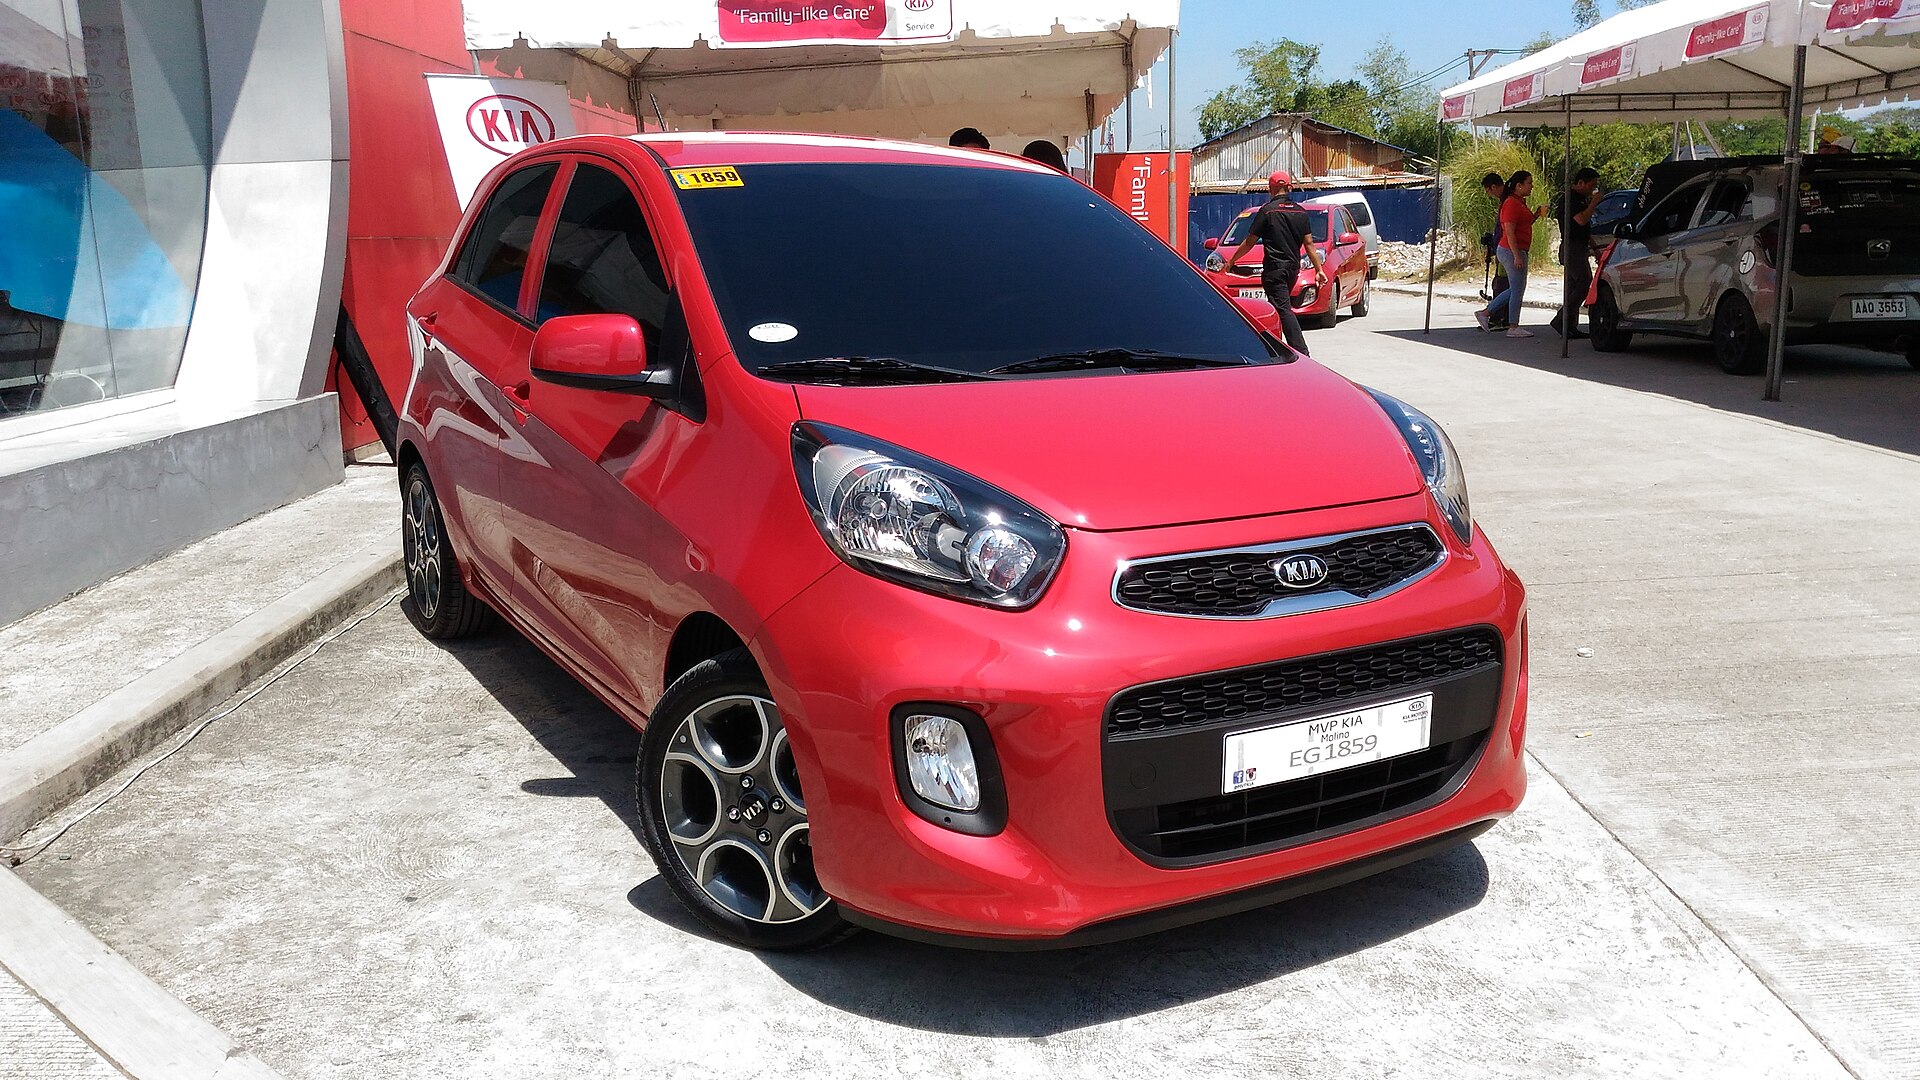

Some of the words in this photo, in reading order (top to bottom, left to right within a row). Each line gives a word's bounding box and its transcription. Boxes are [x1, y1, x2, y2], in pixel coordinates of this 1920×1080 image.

[909, 0, 929, 8] KIA
[733, 7, 829, 25] “Family-like
[833, 5, 875, 20] Care”
[906, 22, 935, 31] Service
[479, 109, 544, 143] KIA
[690, 171, 739, 184] 1859
[1284, 560, 1323, 582] KIA
[1308, 720, 1338, 737] MVP
[1342, 715, 1363, 729] KIA
[1321, 731, 1350, 743] Molino
[742, 800, 765, 821] KIA
